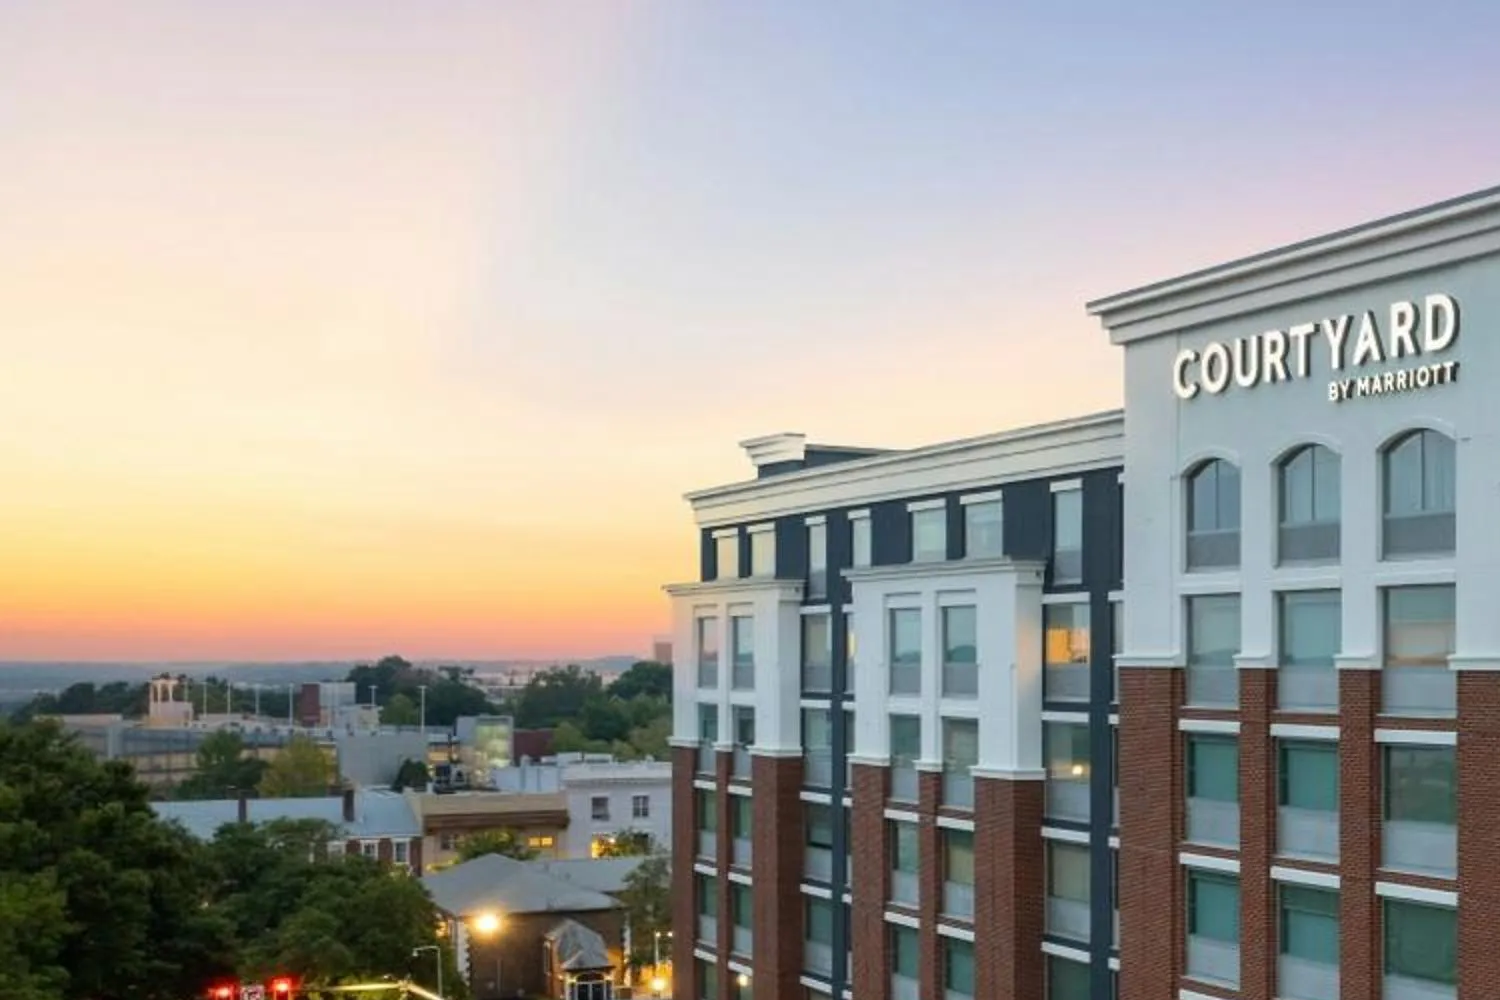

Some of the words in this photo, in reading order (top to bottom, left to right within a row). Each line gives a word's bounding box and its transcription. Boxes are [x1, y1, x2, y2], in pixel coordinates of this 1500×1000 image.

[1173, 293, 1460, 400] COURTYARD
[1328, 380, 1353, 402] BY
[1357, 361, 1459, 397] MARRIOTT
